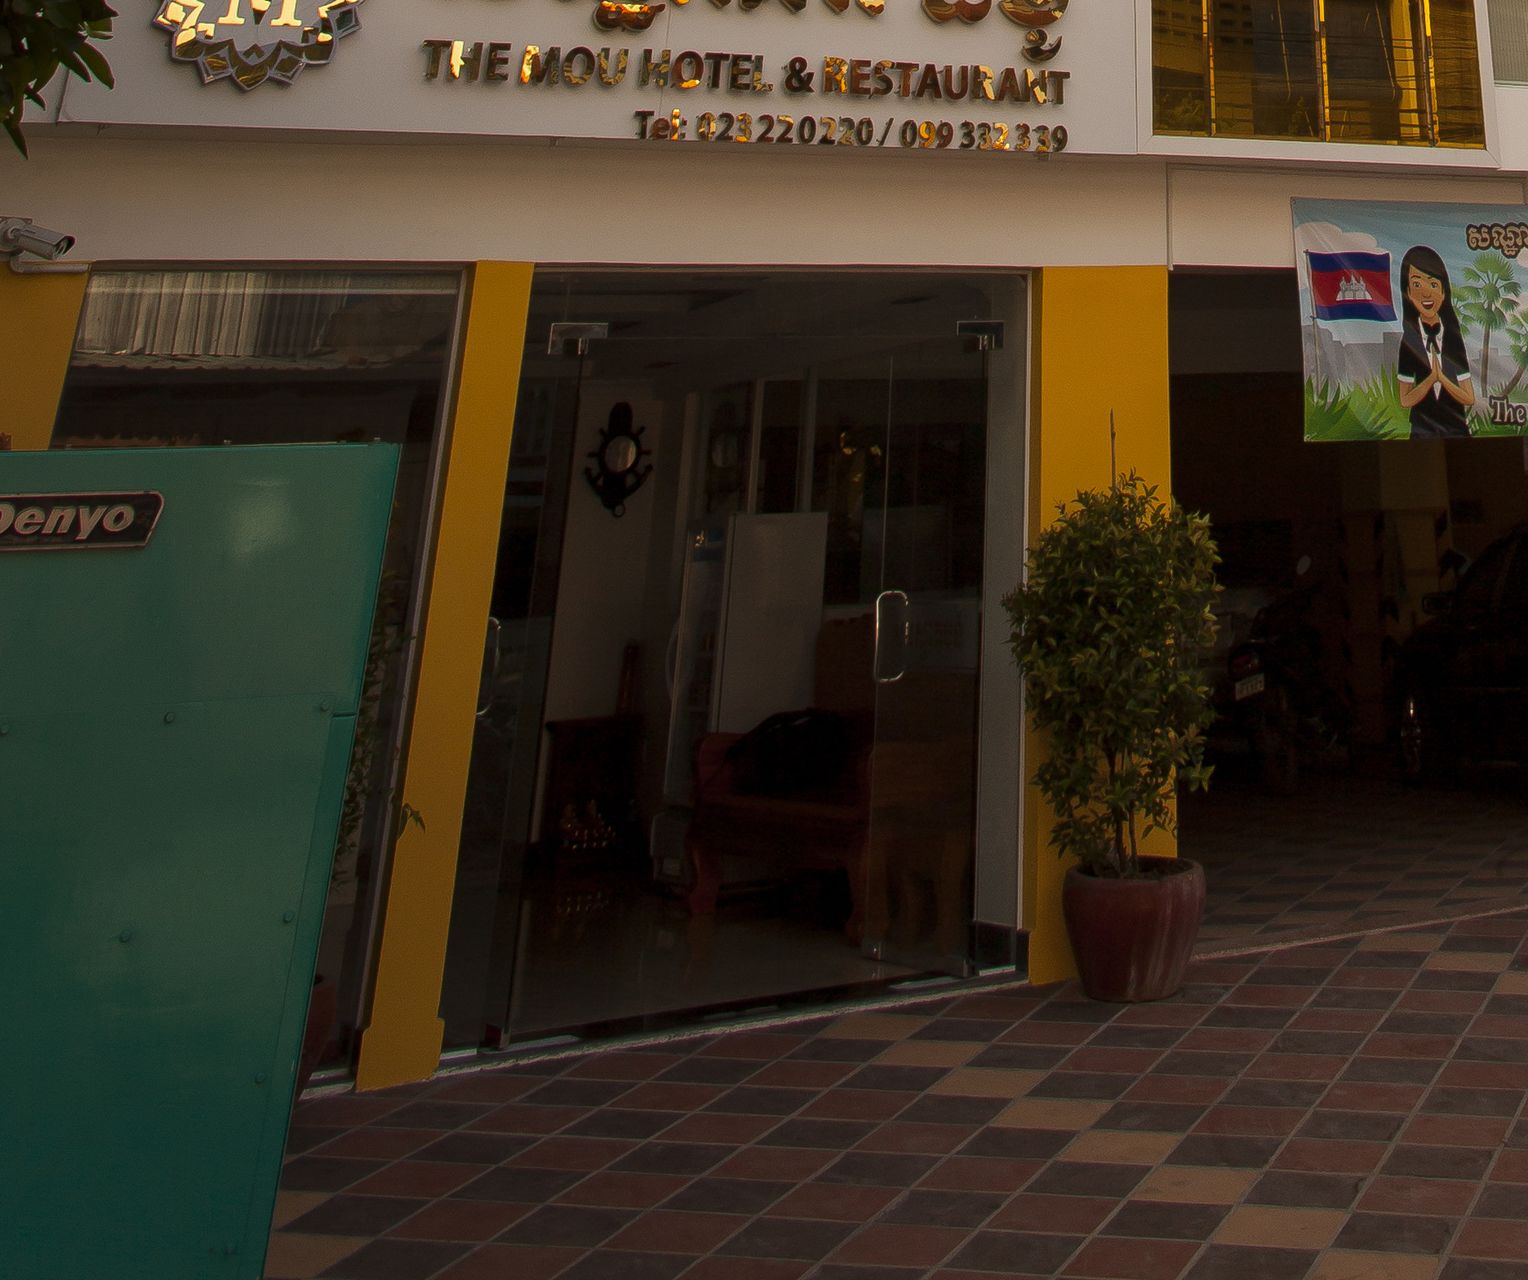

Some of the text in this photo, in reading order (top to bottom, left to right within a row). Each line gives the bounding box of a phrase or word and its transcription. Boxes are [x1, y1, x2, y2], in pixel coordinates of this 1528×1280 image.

[422, 39, 1071, 105] THE MOU HOTEL & RESTAURANT
[635, 107, 688, 142] Tel:
[1490, 395, 1526, 425] The
